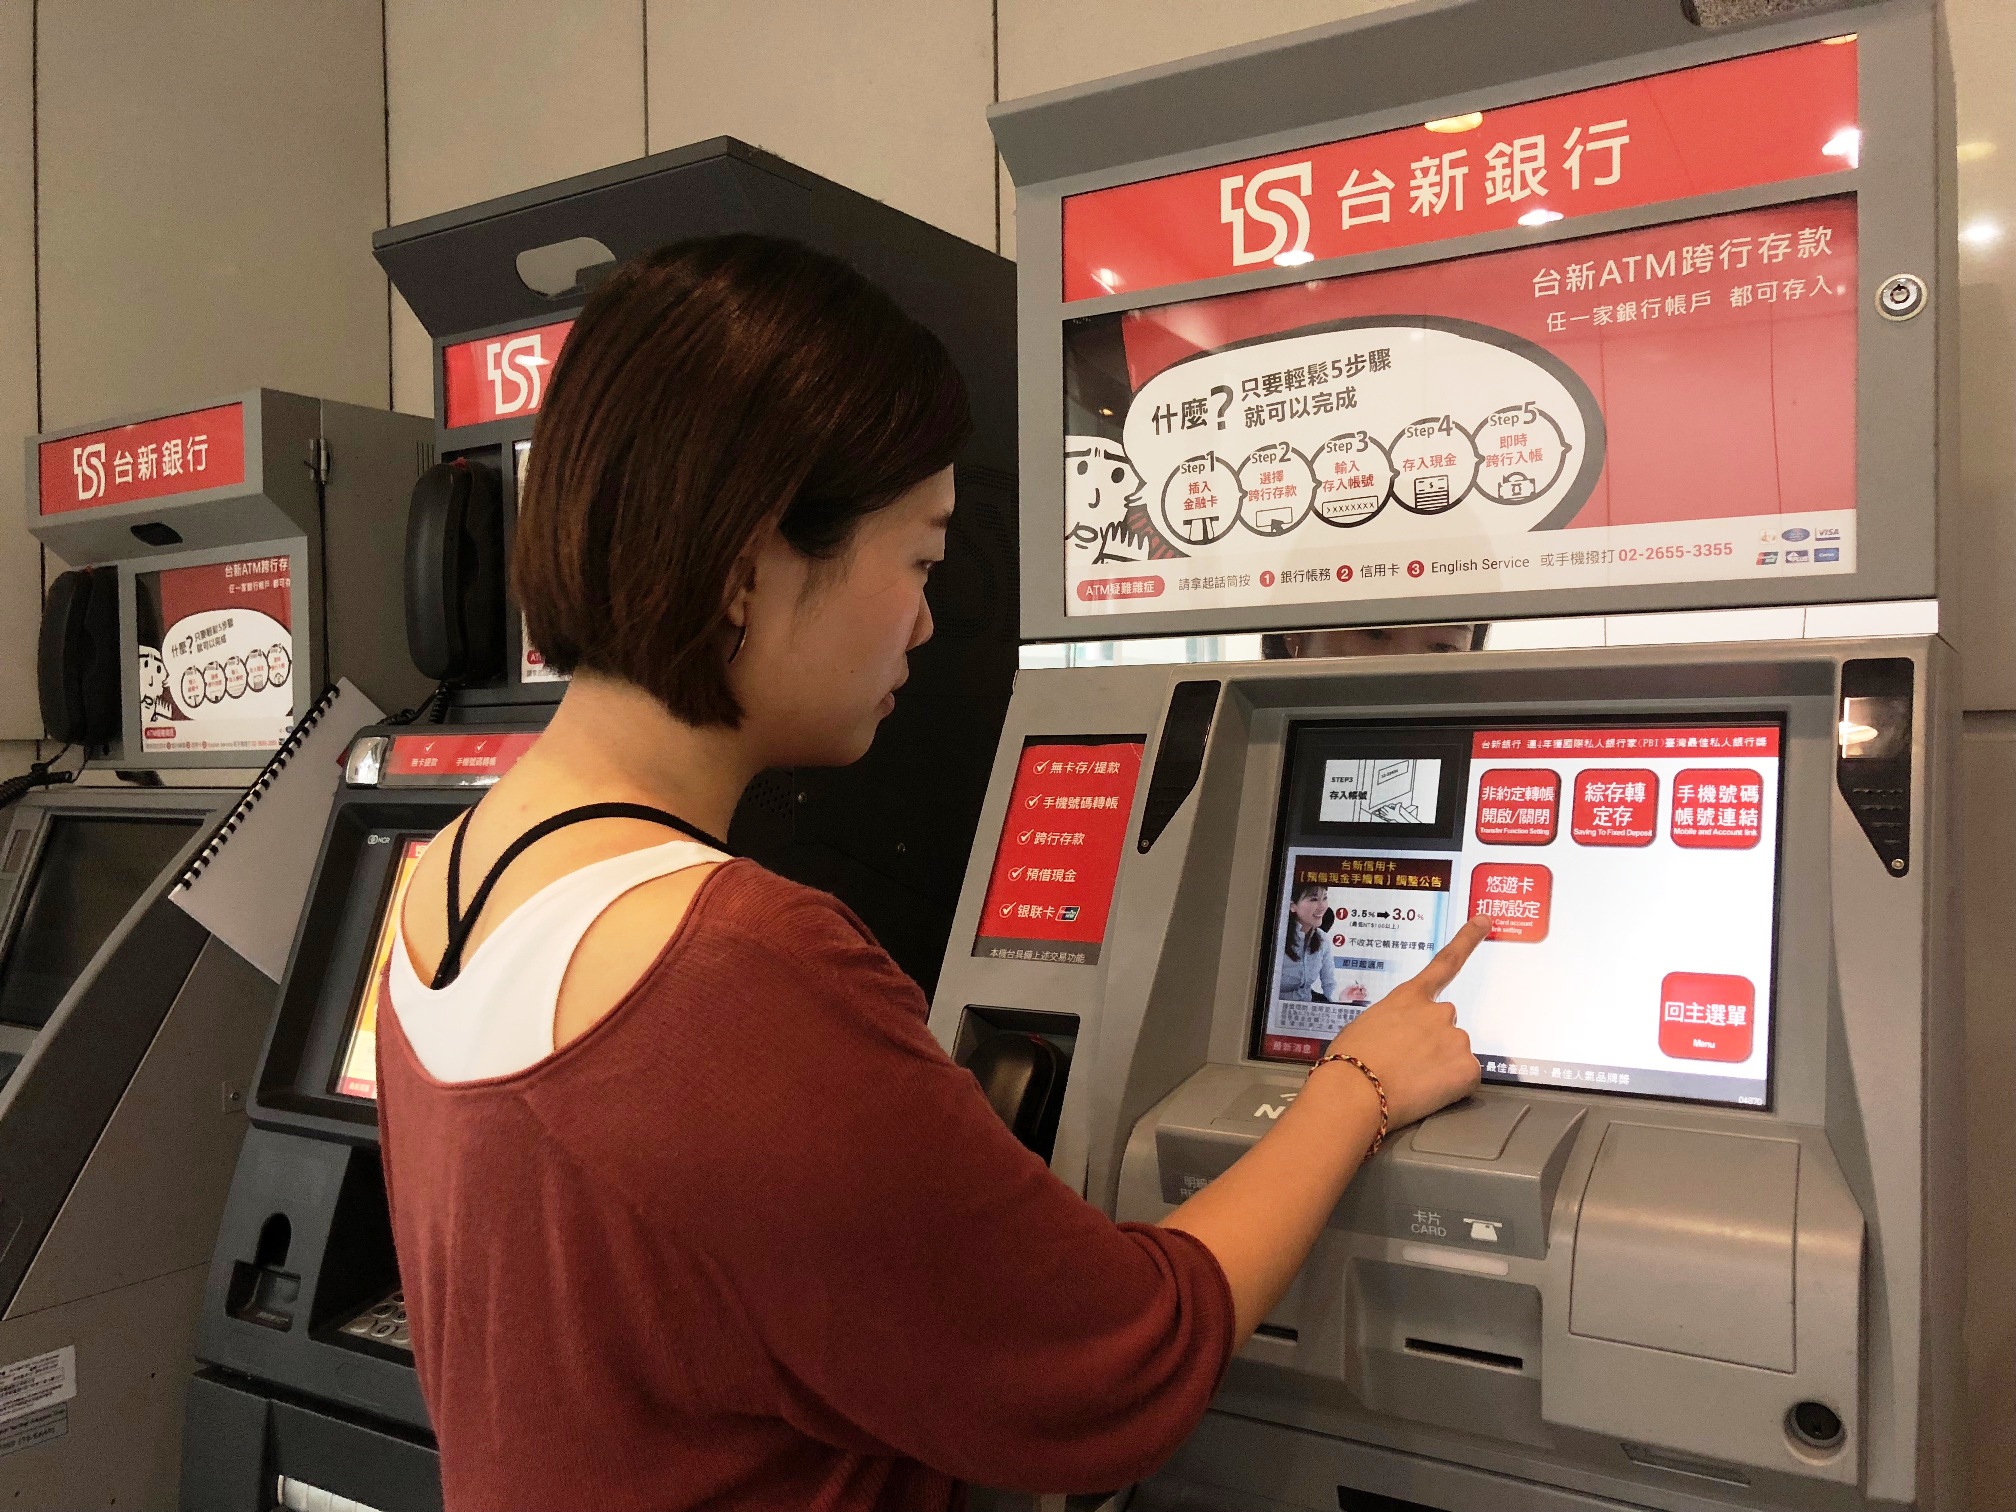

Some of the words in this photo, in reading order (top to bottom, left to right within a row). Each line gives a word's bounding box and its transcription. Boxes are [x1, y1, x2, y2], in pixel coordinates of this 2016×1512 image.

[1336, 119, 1631, 230] 台新銀行
[1532, 225, 1833, 298] 台新ATM跨行存款
[1546, 290, 1712, 332] 任一家銀行帳戶
[1241, 347, 1392, 401] 只要輕鬆5步驟
[1151, 385, 1234, 436] 什麼?
[1244, 386, 1358, 429] 就可以完成
[1499, 433, 1528, 449] 即時
[113, 434, 209, 485] 台新銀行
[1334, 459, 1360, 475] 輸入
[1402, 452, 1457, 473] 存入現金
[1485, 447, 1544, 468] 跨行入帳
[1259, 469, 1284, 485] 選擇
[1322, 473, 1375, 493] 存入帳號
[1188, 480, 1212, 495] 插入
[1248, 484, 1297, 502] 跨行存款
[1183, 494, 1218, 511] 金融卡
[1085, 580, 1155, 597] ATM疑難雜症
[1178, 574, 1251, 591] 請拿起話筒按
[1280, 567, 1331, 584] 銀行帳務
[1359, 563, 1400, 579] 信用卡
[1430, 560, 1479, 575] English
[1481, 556, 1530, 570] Service
[1540, 549, 1616, 567] 或手機撥打
[1618, 542, 1734, 562] 02-2655-3355
[1049, 761, 1121, 774] 無卡存/提款
[1481, 786, 1555, 802] 非約定轉帳
[1584, 782, 1646, 803] 綜存轉
[1677, 784, 1760, 804] 手機號碼
[1042, 796, 1119, 810] 手機號碼轉帳
[1592, 805, 1633, 827] 定存
[1675, 807, 1759, 827] 帳號連結
[1033, 832, 1086, 846] 跨行存款
[1573, 828, 1597, 836] Saving
[1673, 827, 1697, 835] Mobile
[1712, 828, 1743, 836] Account
[1025, 868, 1077, 883] 預借現金
[1485, 875, 1535, 895] 悠遊卡
[1017, 904, 1055, 919] 银联卡
[1475, 898, 1541, 919] 扣款設定
[1664, 1001, 1747, 1027] 回主選單
[1692, 1038, 1716, 1049] Menu
[1412, 1209, 1441, 1226] 卡片
[1411, 1223, 1447, 1237] CARD
